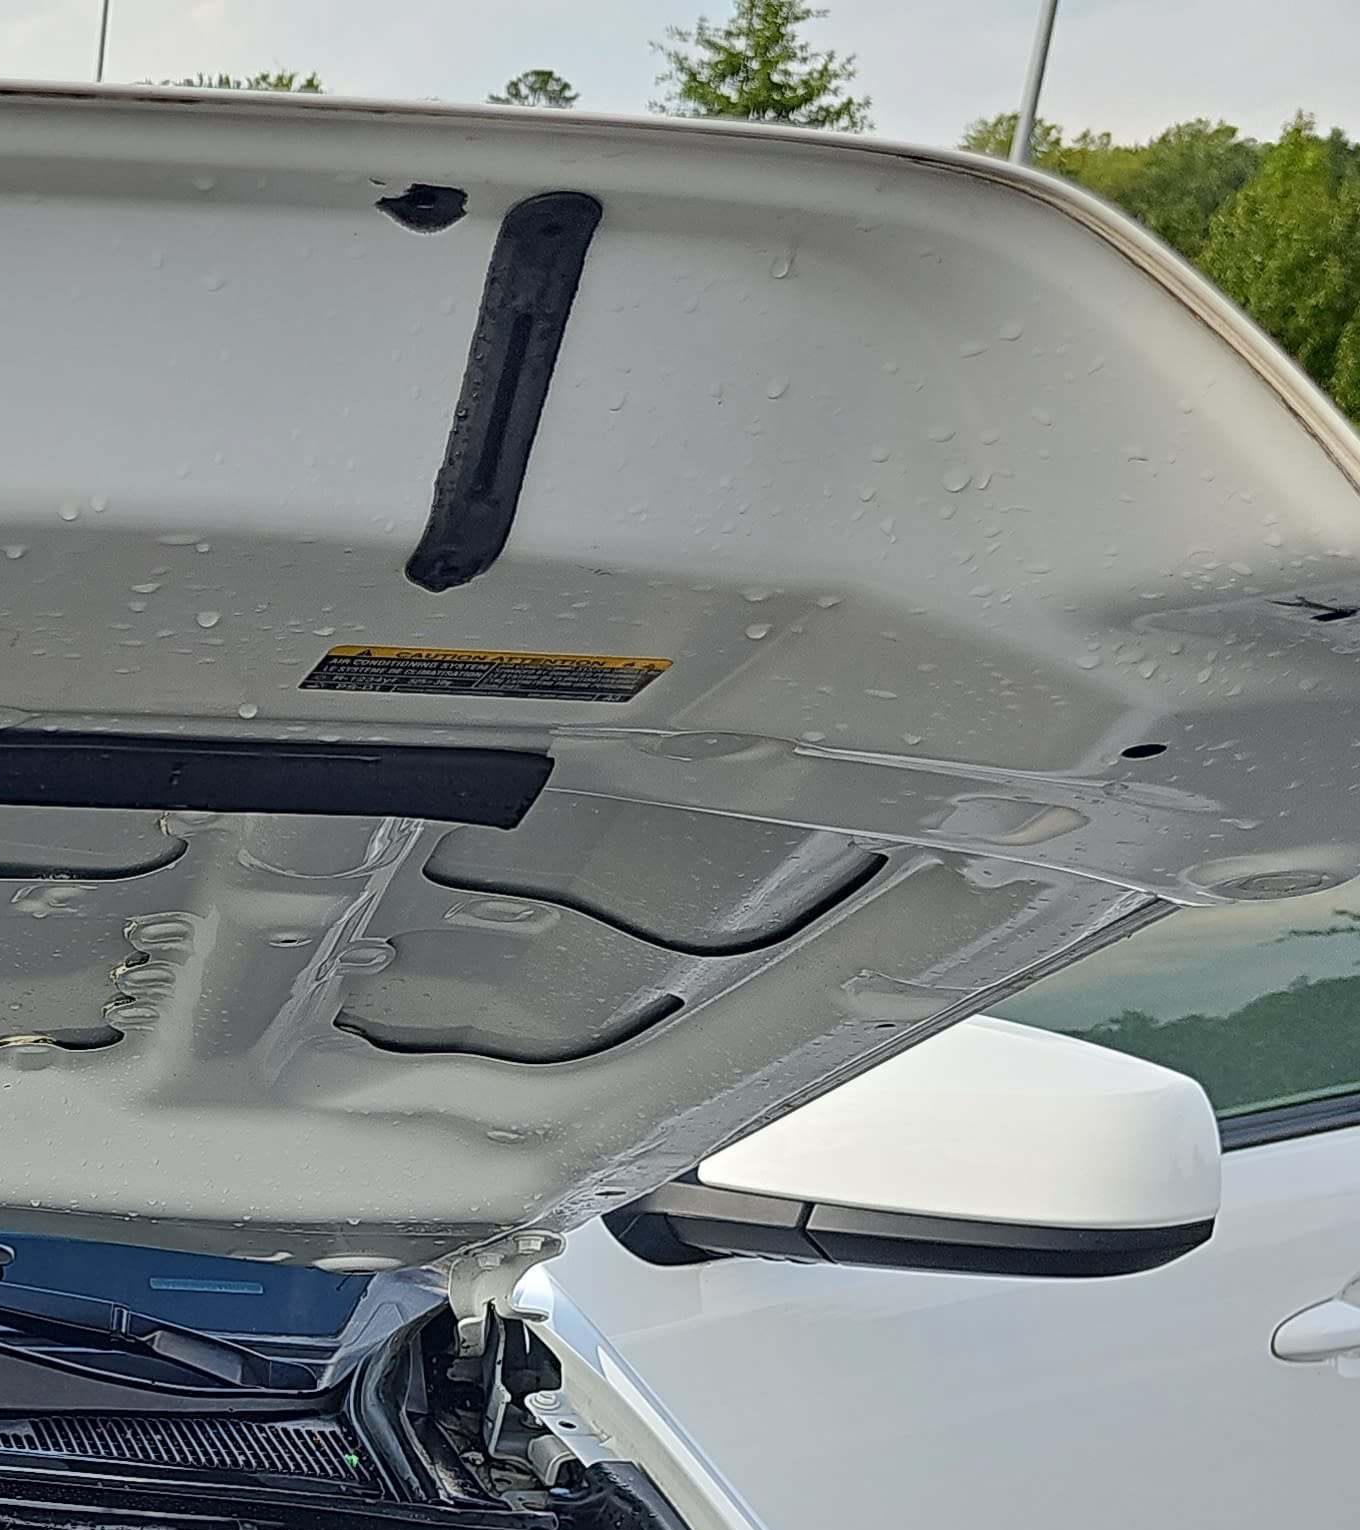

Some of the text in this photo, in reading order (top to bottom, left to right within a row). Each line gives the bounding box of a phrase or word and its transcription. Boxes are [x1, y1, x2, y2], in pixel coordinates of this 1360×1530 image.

[352, 659, 438, 669] CONDITIONING
[439, 662, 489, 670] SYSTEM
[395, 651, 607, 667] CAUTION ATTENTION
